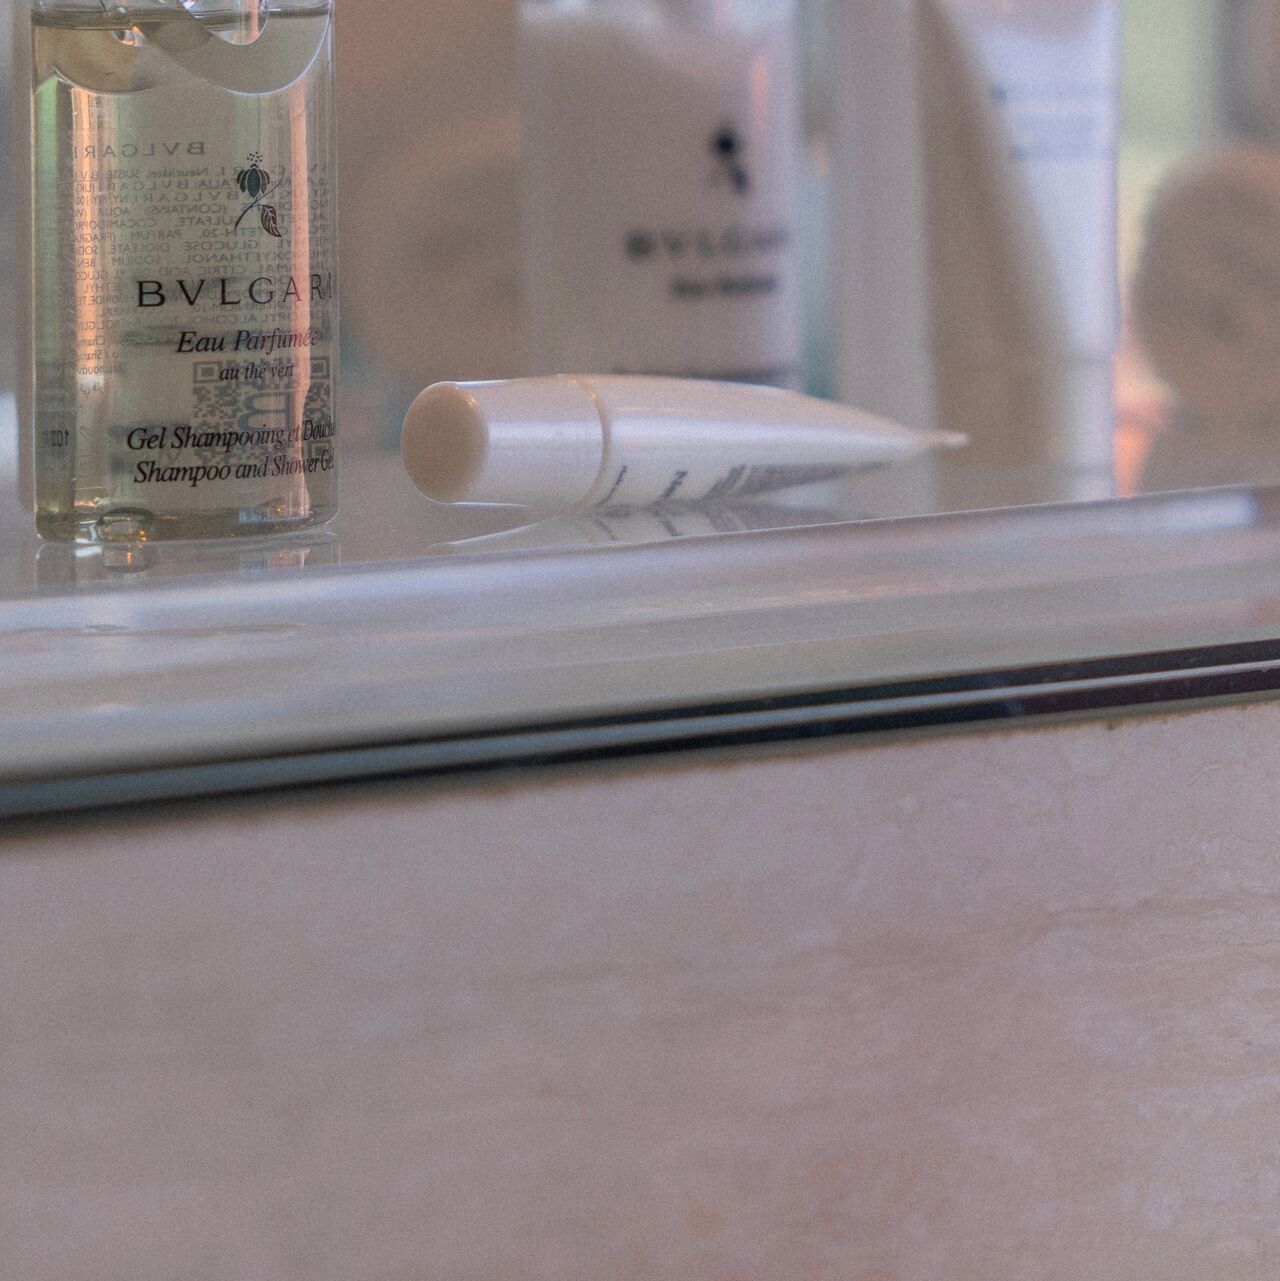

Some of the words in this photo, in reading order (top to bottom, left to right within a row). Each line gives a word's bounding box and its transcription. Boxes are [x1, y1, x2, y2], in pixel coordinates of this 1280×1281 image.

[136, 271, 333, 308] BVLGARI
[175, 330, 225, 353] Eau
[233, 326, 319, 355] Parfumée
[219, 368, 240, 381] au
[270, 362, 295, 378] vert
[127, 425, 167, 451] Gel
[170, 423, 285, 452] Shampooing
[287, 423, 300, 442] et
[134, 459, 231, 487] Shampoo
[234, 456, 269, 479] and
[271, 453, 320, 478] Shower
